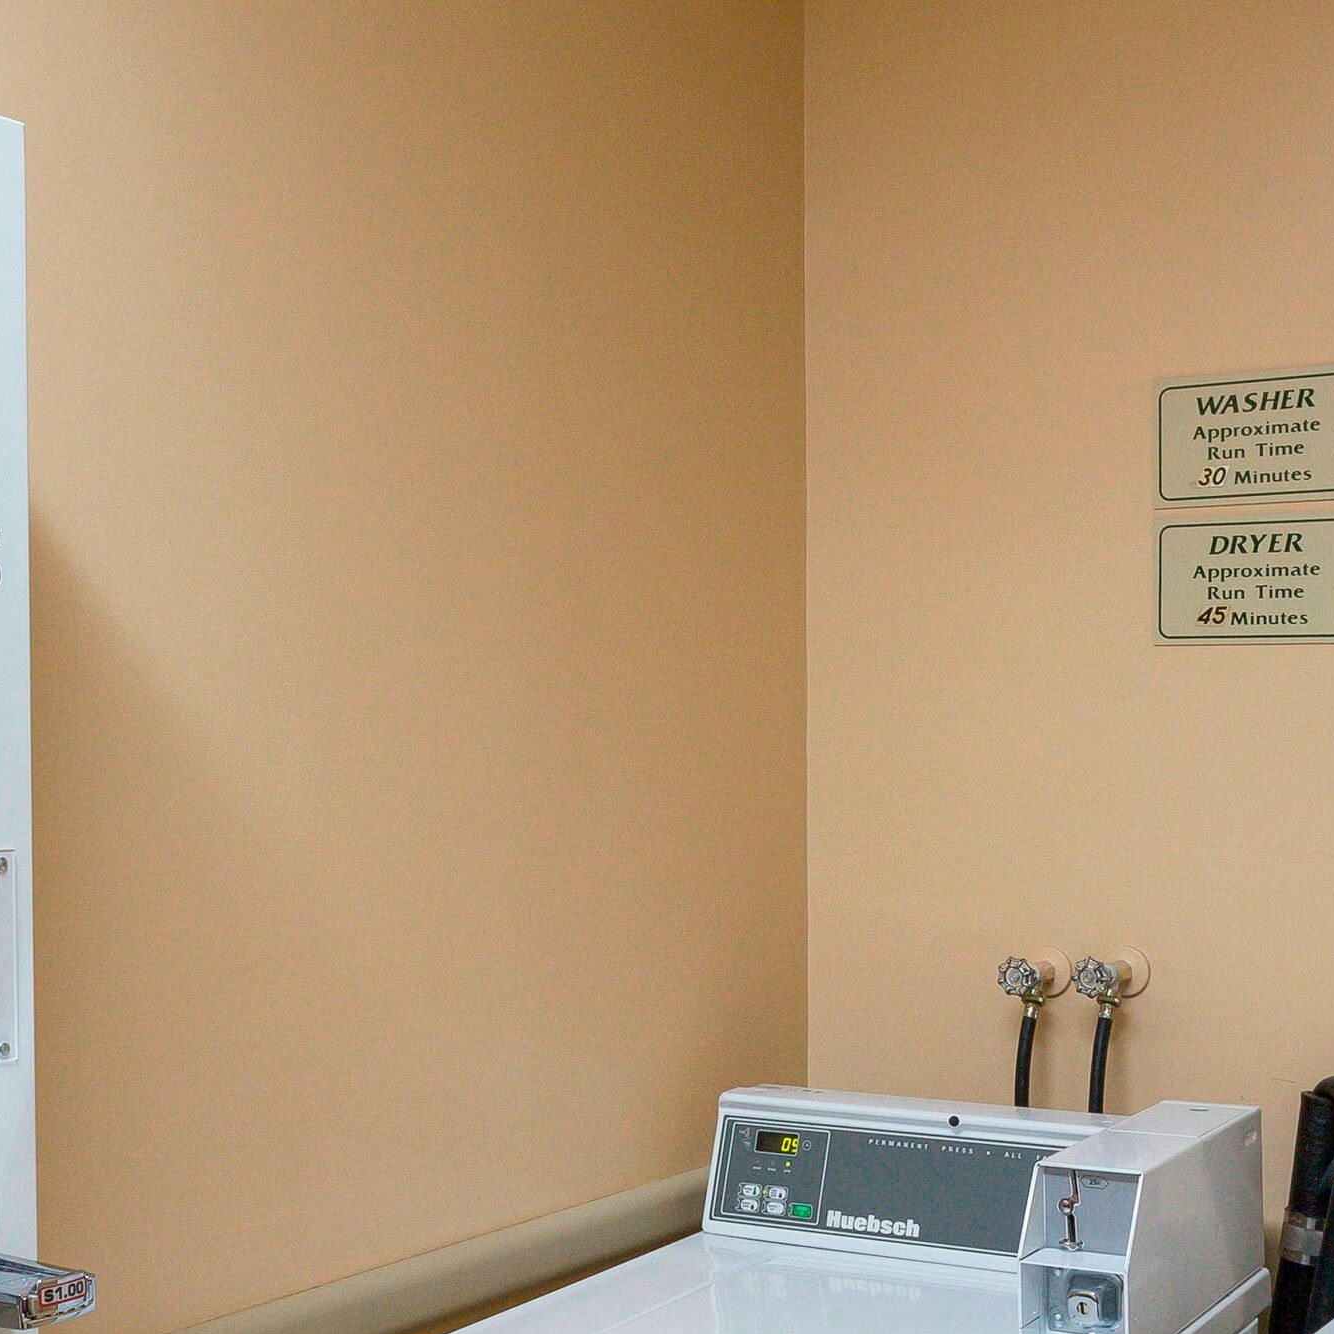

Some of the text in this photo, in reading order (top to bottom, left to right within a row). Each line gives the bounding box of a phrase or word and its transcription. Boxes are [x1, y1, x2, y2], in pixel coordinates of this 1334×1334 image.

[1195, 387, 1316, 416] WASHER
[1192, 418, 1321, 443] Approximate
[1207, 441, 1305, 461] Run Time
[1197, 466, 1313, 487] 30 Minutes
[1208, 532, 1304, 556] DRYER
[1192, 562, 1321, 583] Approximate
[1207, 584, 1305, 601] Run Time
[1196, 606, 1309, 627] 45 Minutes
[868, 1138, 1023, 1160] PERMANENT PRESS ALL
[826, 1209, 921, 1238] Huebsch
[44, 1280, 84, 1303] $1.00
